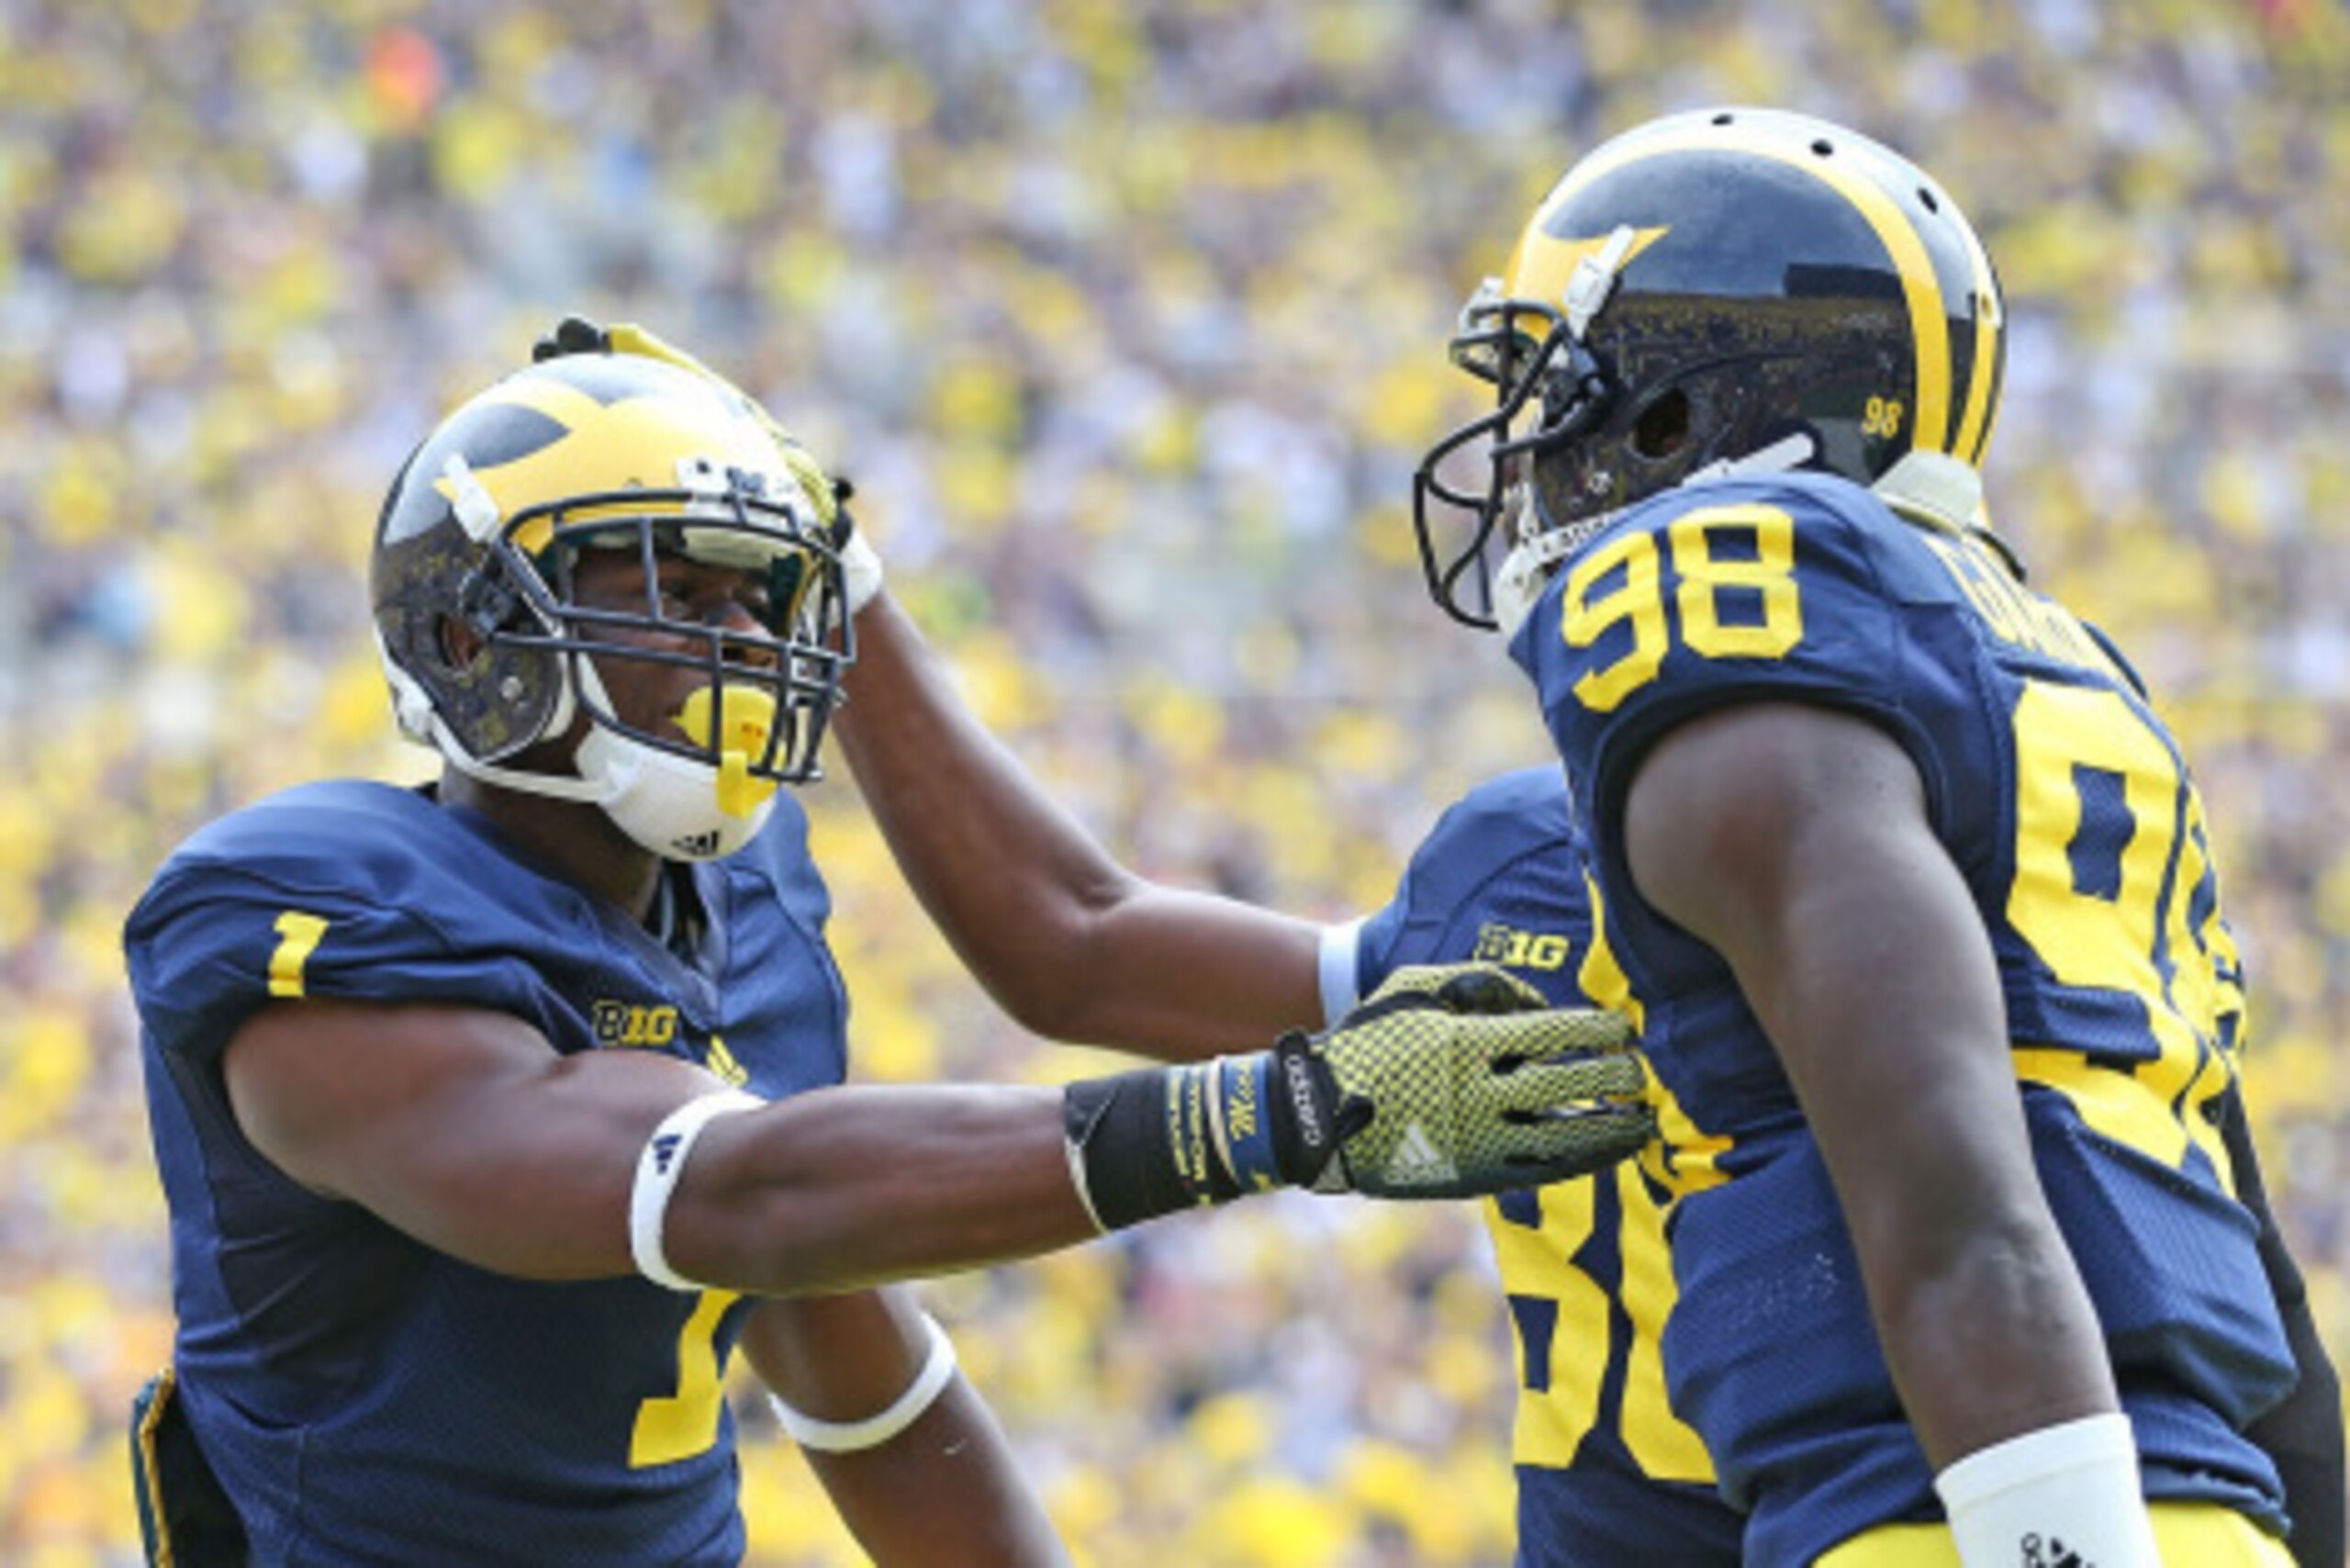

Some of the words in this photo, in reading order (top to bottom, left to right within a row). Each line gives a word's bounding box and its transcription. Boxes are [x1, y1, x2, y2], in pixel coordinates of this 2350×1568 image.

[1863, 396, 1904, 439] 98
[1561, 502, 1804, 712] 98
[268, 911, 330, 997] 1
